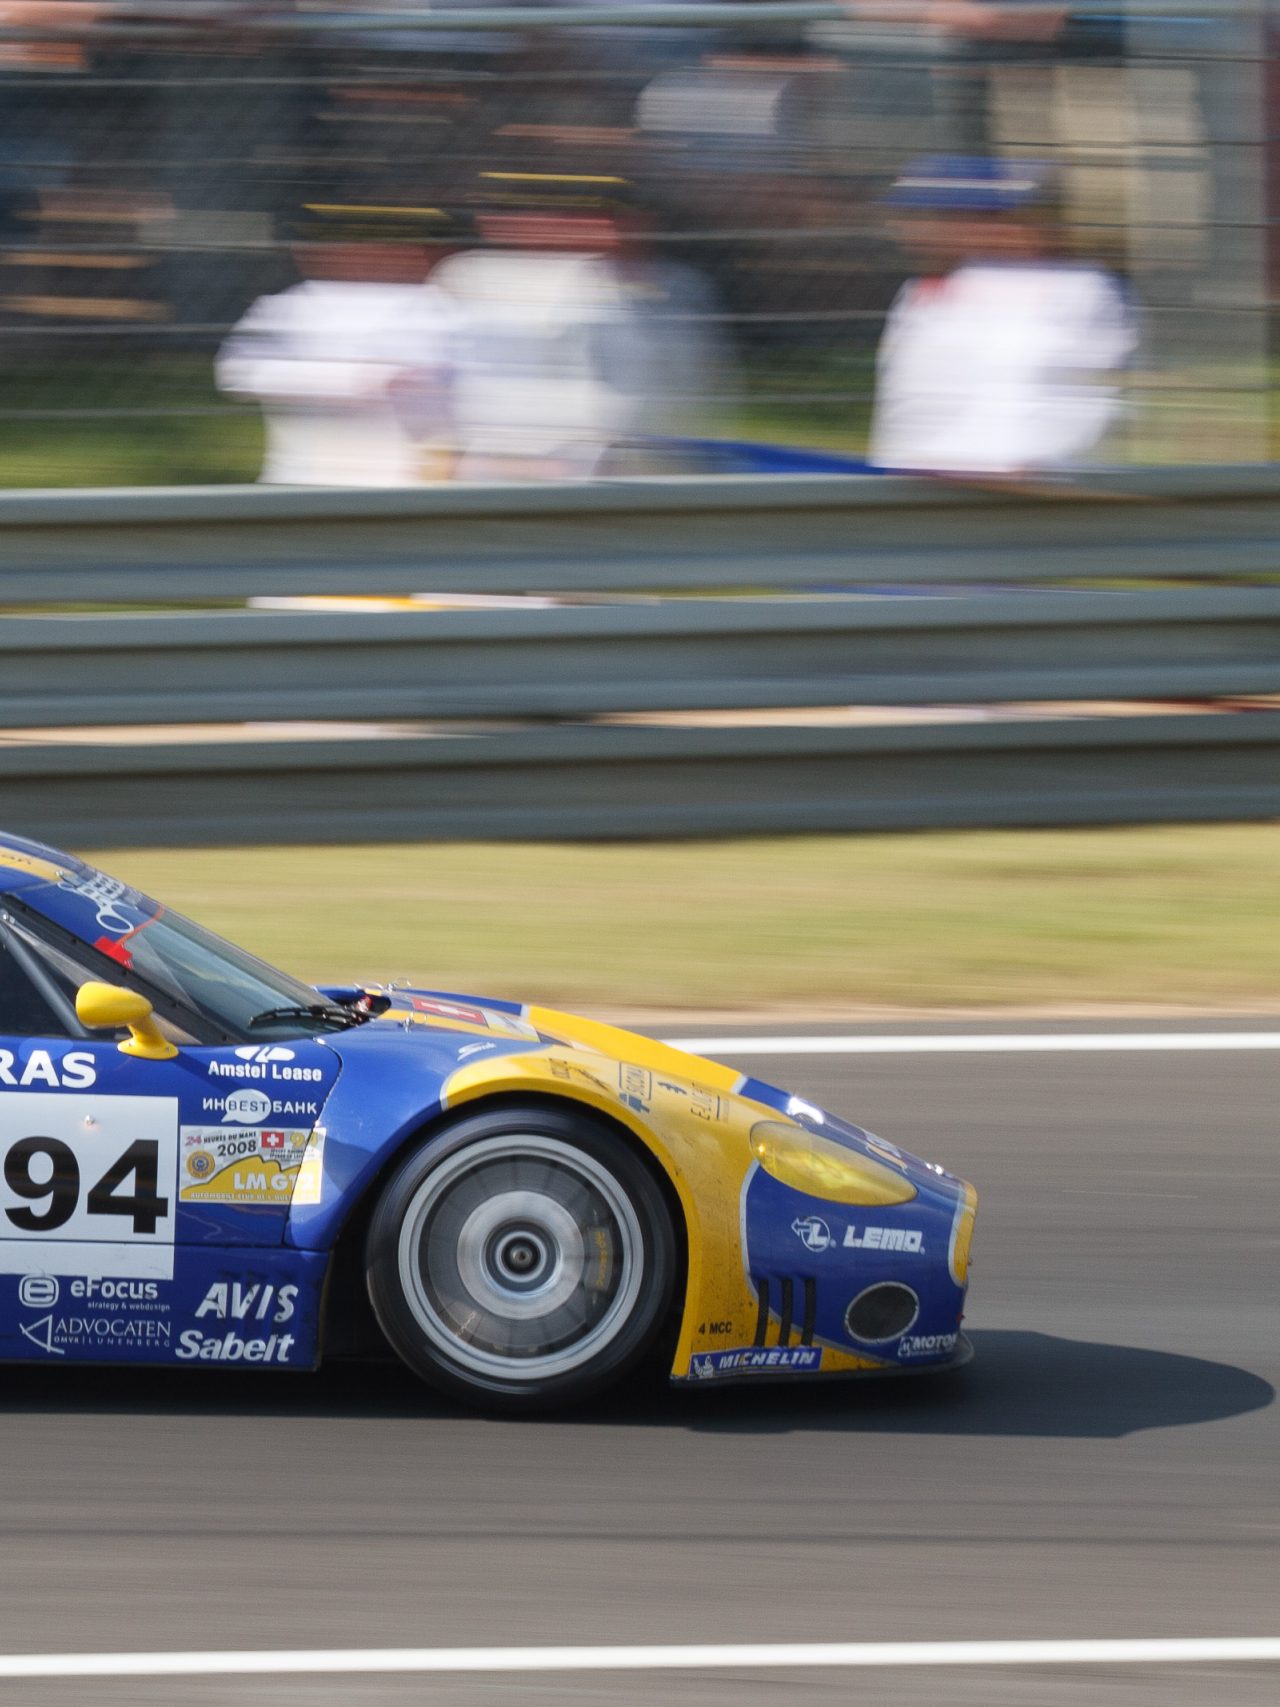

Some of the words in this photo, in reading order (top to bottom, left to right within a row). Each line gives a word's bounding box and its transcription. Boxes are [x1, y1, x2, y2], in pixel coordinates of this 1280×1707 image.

[208, 1060, 267, 1079] Amstel
[272, 1064, 322, 1082] Lease
[217, 1141, 257, 1157] 2008
[3, 1135, 169, 1235] 94
[842, 1224, 923, 1253] LEMO
[70, 1276, 158, 1300] eFocus
[87, 1302, 119, 1311] strategy
[129, 1302, 171, 1313] webdesign
[194, 1281, 299, 1323] AVIS
[54, 1317, 171, 1338] ADVOCATEN
[698, 1322, 706, 1335] 4
[708, 1321, 733, 1335] MCC
[175, 1329, 296, 1363] Sabelt
[719, 1350, 816, 1369] MICHELIN
